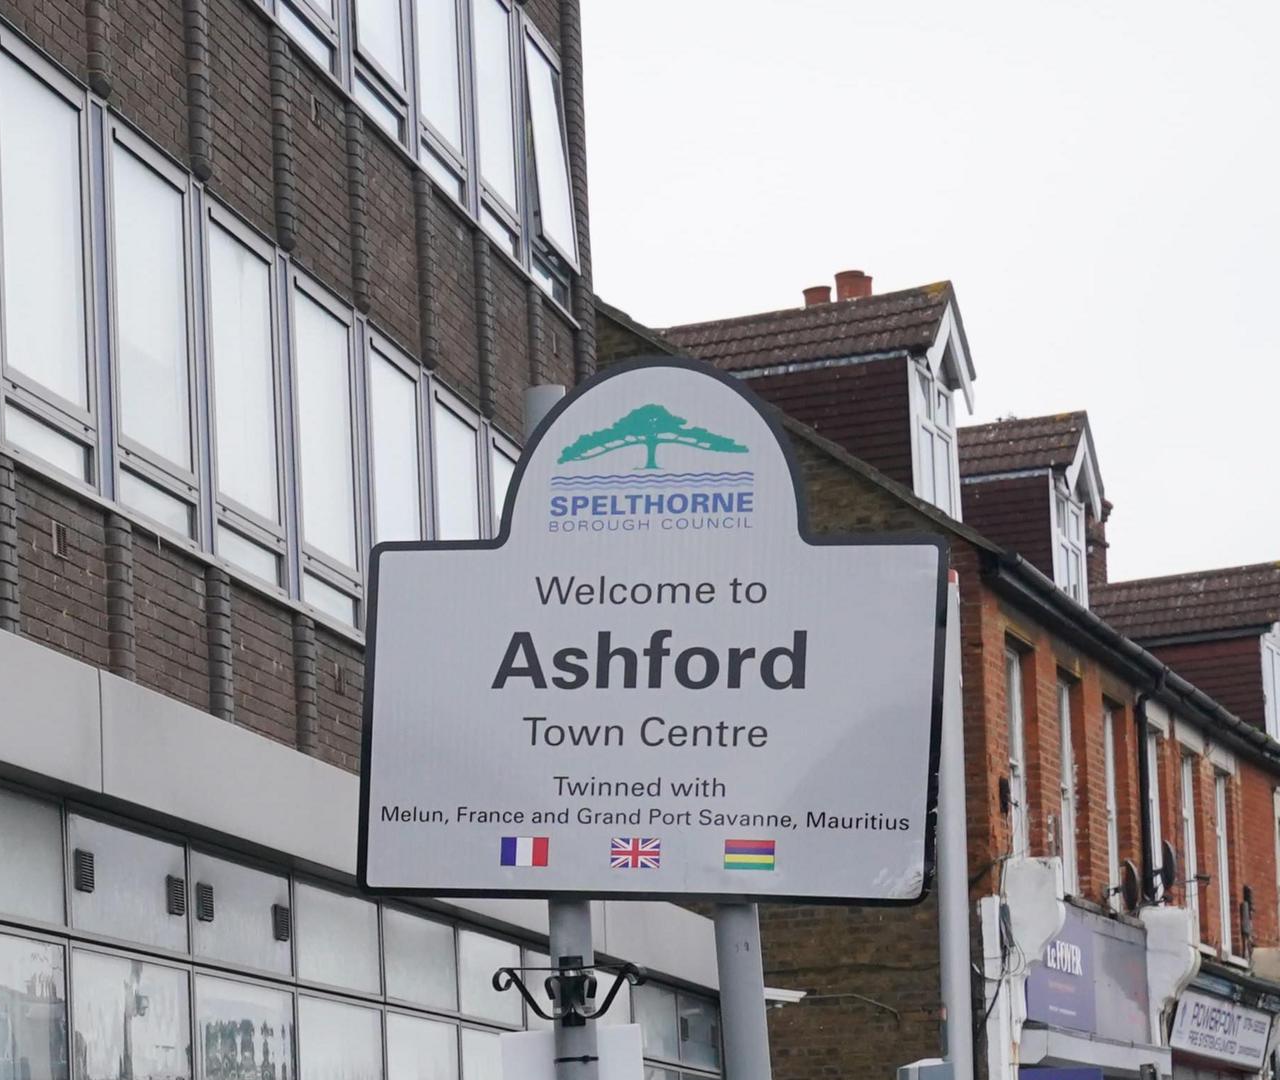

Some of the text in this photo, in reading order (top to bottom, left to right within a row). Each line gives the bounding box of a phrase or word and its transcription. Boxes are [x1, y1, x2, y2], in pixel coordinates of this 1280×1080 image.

[550, 492, 753, 517] SPELTHORNE
[549, 516, 753, 533] BOROUGH COUNCIL
[535, 576, 767, 605] Welcome to
[491, 629, 808, 691] Ashford
[523, 716, 768, 747] Town Centre
[553, 776, 726, 798] Twinned with
[381, 806, 910, 832] Melun, France and Grand Port Savanne, Mauritius
[1056, 940, 1082, 976] FOYER
